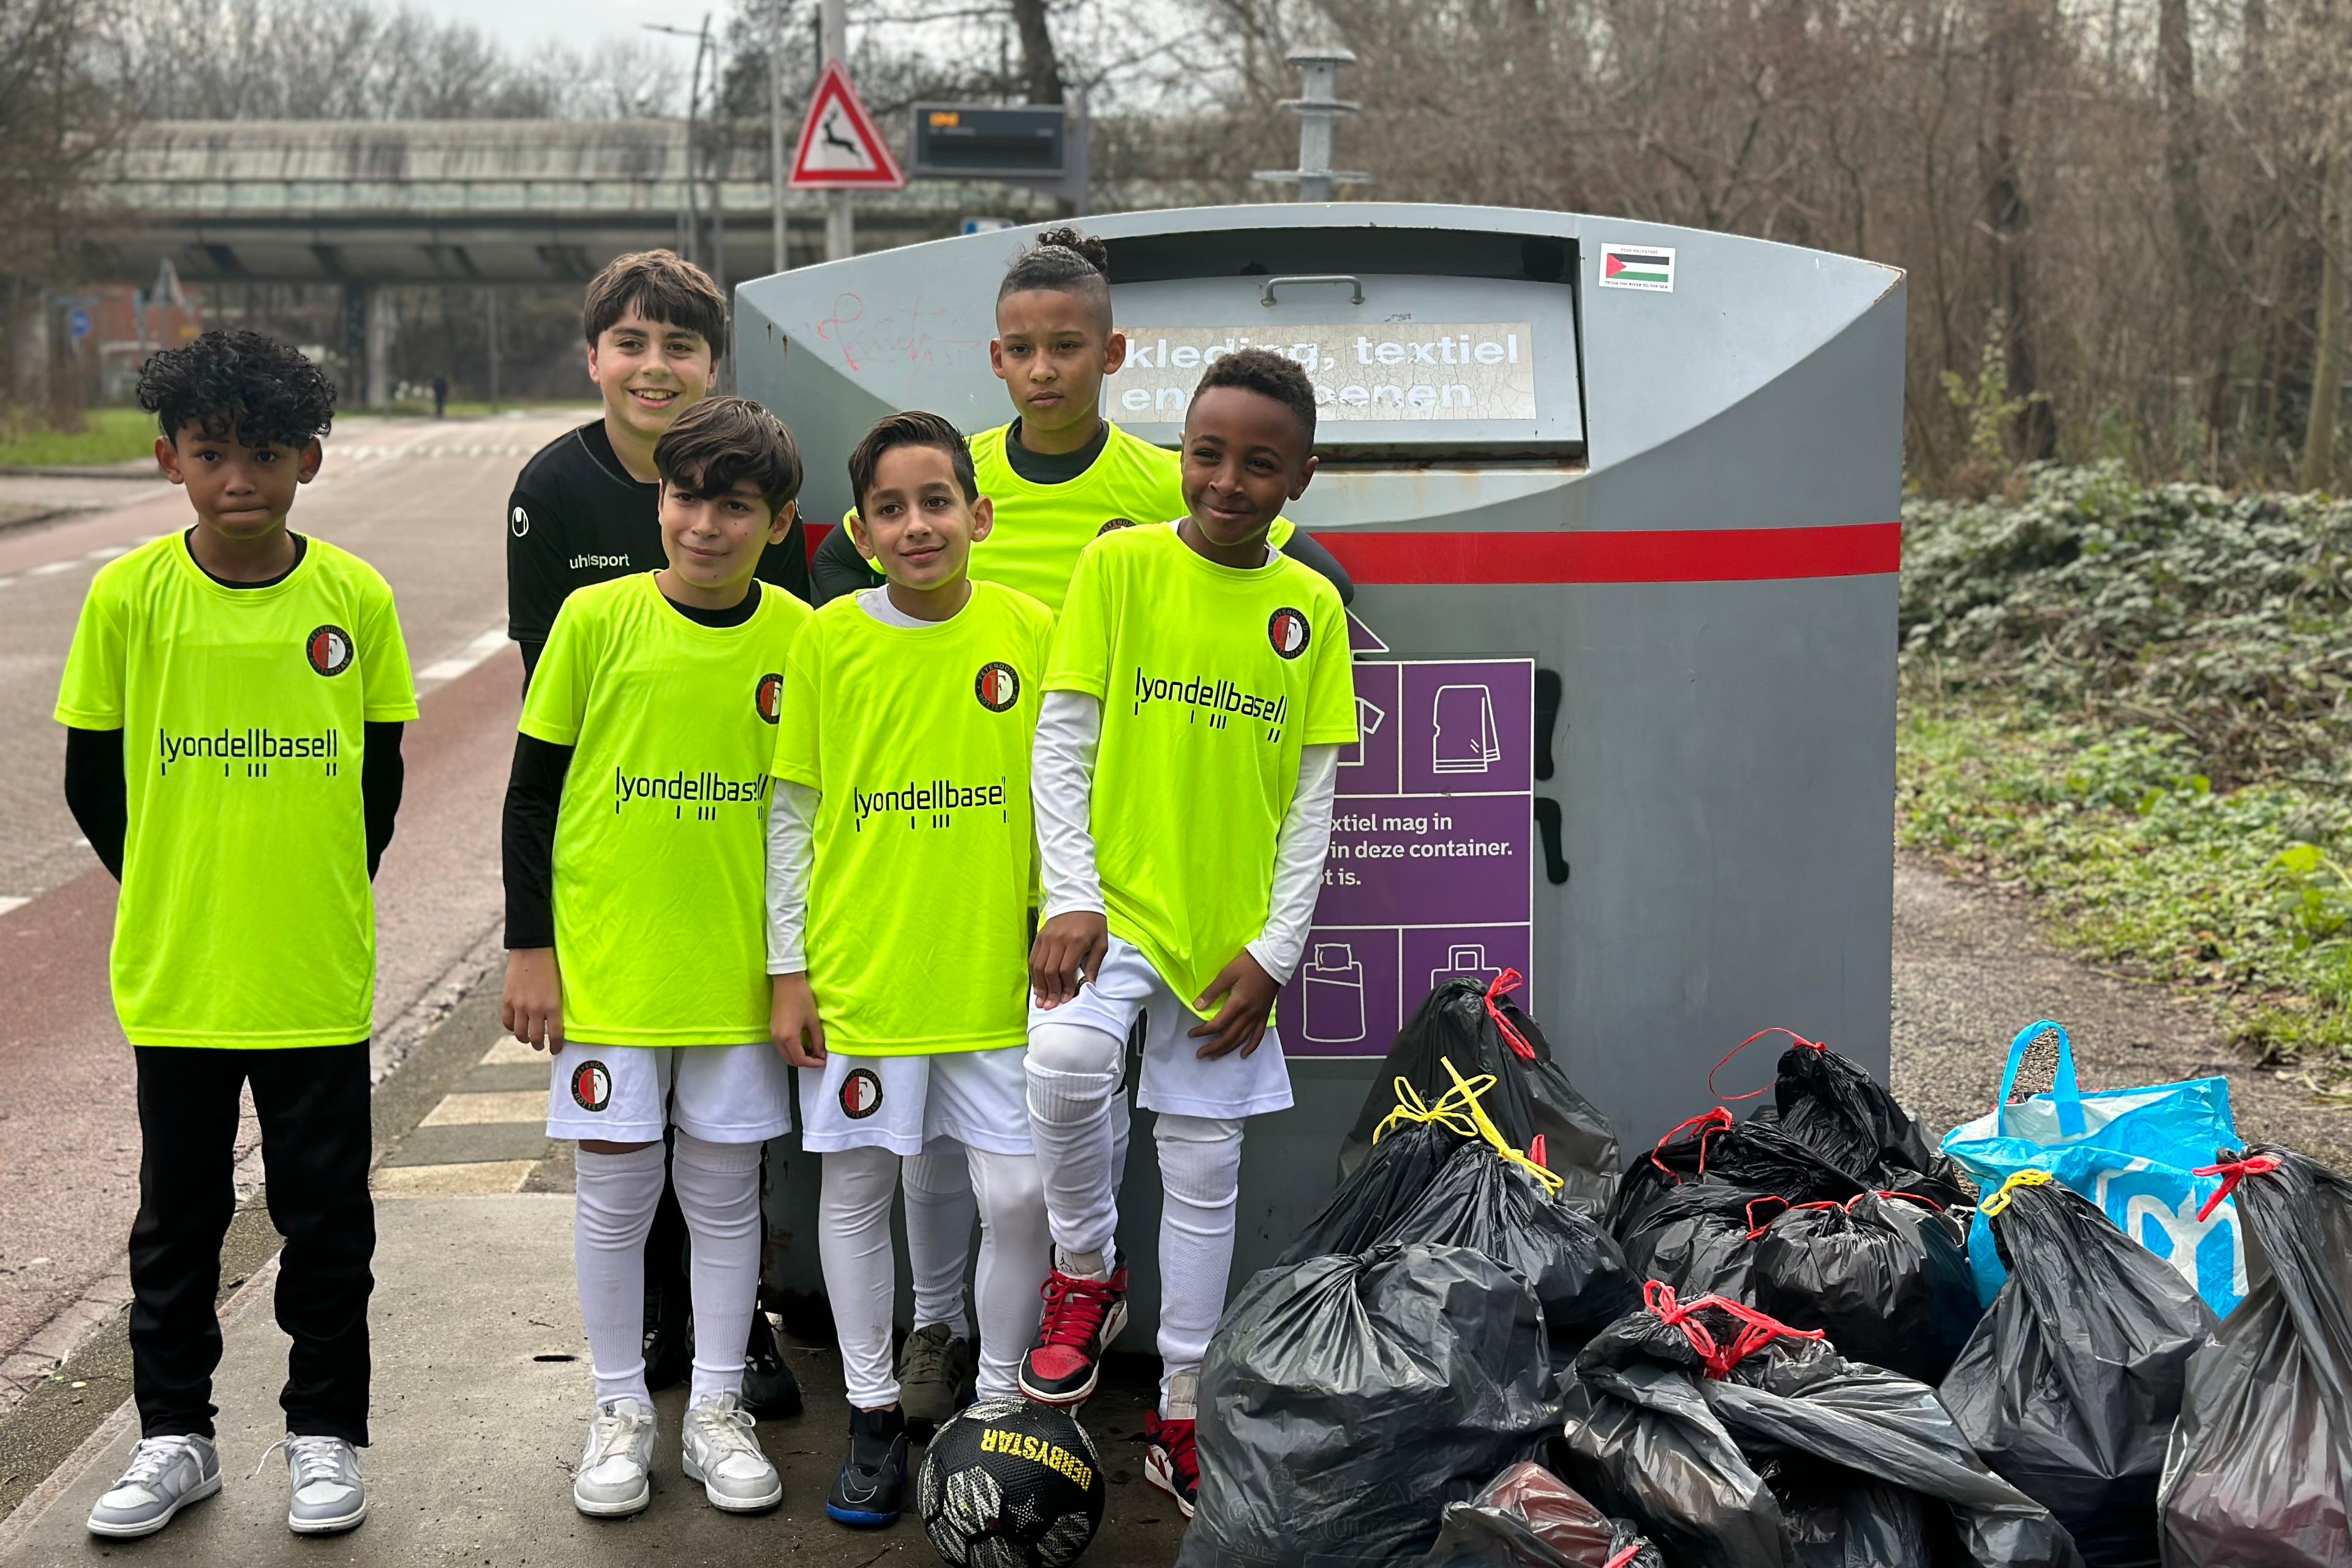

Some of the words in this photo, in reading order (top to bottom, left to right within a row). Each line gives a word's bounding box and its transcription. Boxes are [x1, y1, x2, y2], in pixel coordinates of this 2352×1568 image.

[1353, 334, 1518, 365] textiel
[1121, 388, 1186, 411] en
[569, 554, 630, 569] uhlsport
[1135, 666, 1287, 725] lyondellbasell
[160, 728, 338, 763] lyondellbasell
[1331, 813, 1378, 832] xtiel
[1382, 816, 1428, 835] mag
[1432, 813, 1452, 831] in
[1330, 841, 1349, 858] in
[1354, 840, 1405, 859] deze
[1409, 839, 1513, 858] container.
[1337, 867, 1362, 886] is.
